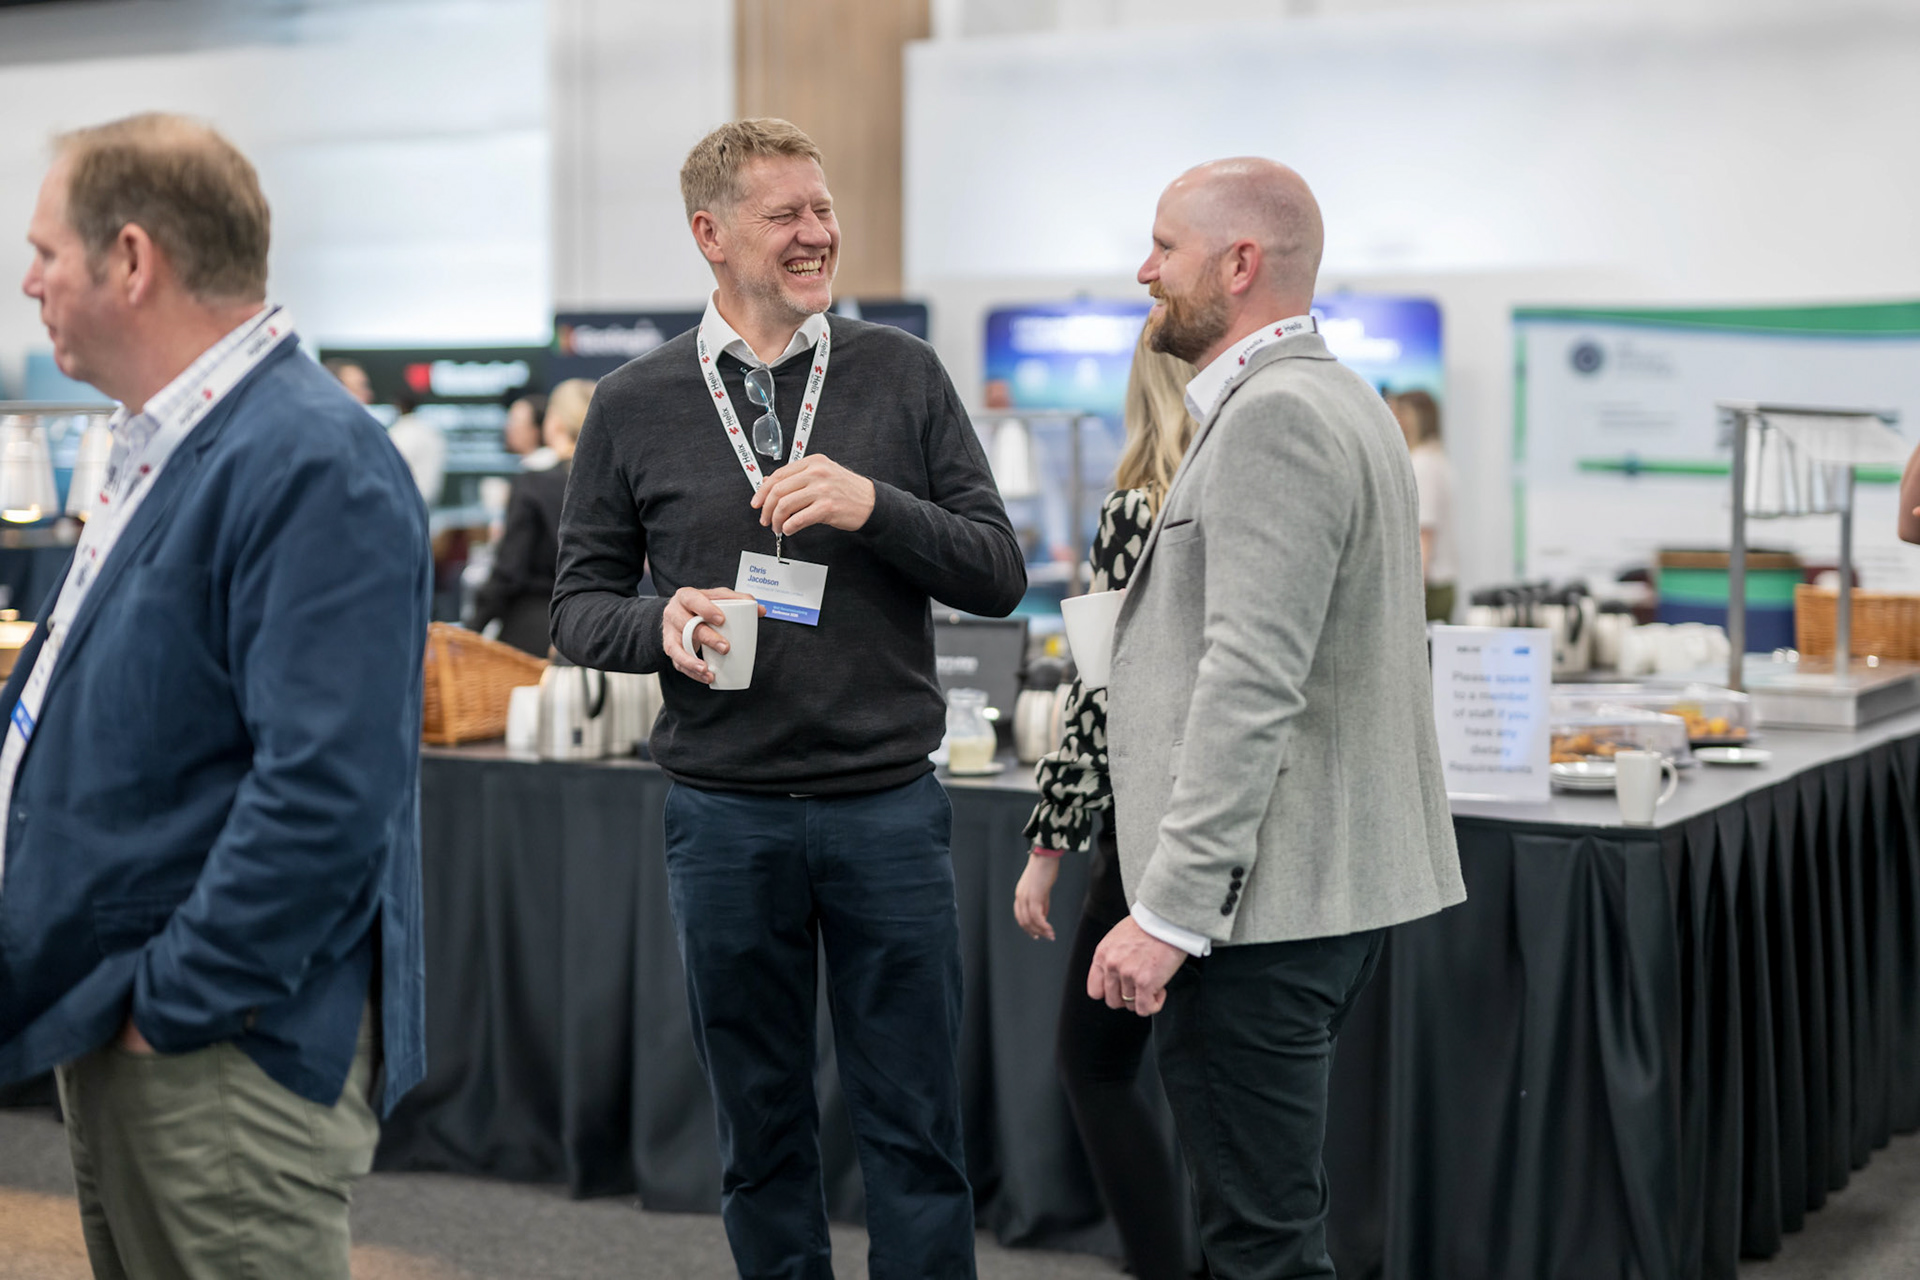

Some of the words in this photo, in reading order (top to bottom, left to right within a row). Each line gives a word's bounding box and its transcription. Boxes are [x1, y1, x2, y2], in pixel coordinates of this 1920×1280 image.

[820, 340, 828, 358] Helix
[708, 370, 720, 391] Helix
[810, 376, 822, 394] Helix
[722, 407, 734, 427] Helix
[801, 412, 812, 432] Helix
[738, 444, 750, 464] Helix
[750, 566, 766, 574] Chris
[748, 574, 779, 586] Jacobson
[1452, 670, 1492, 682] Please
[1454, 691, 1465, 699] to
[1454, 708, 1464, 717] of
[1508, 712, 1530, 720] you
